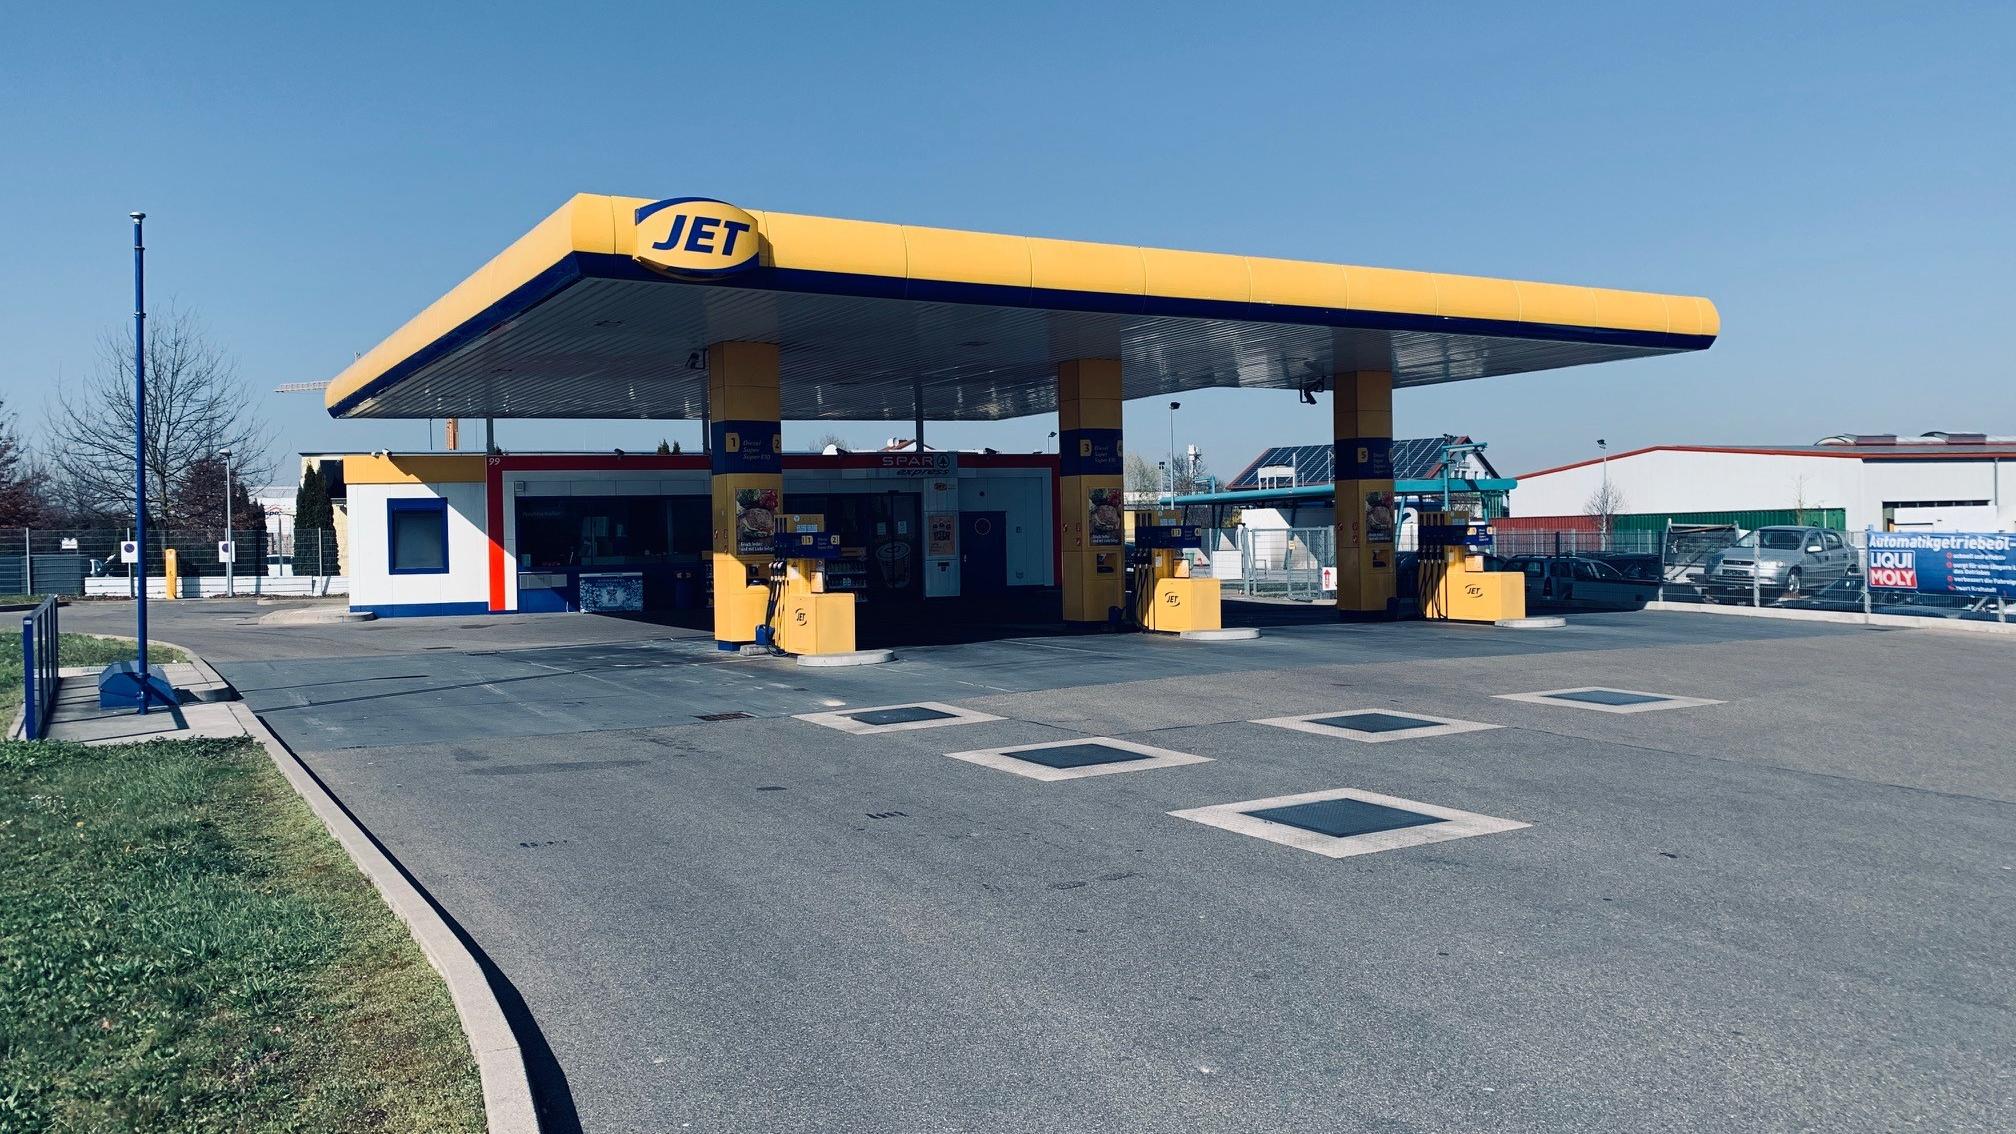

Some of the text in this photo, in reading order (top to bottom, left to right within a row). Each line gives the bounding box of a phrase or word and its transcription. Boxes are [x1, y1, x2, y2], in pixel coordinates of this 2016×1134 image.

[651, 214, 751, 256] JET
[731, 438, 736, 447] 1
[774, 439, 780, 449] 2
[1361, 451, 1367, 459] 5
[489, 458, 501, 466] 99
[882, 456, 934, 466] SPAR
[896, 468, 949, 478] express
[1870, 552, 1913, 569] LIQUI
[1871, 569, 1914, 586] MOLY
[1467, 587, 1481, 595] JET
[1166, 595, 1179, 604] JET
[796, 612, 806, 621] JET
